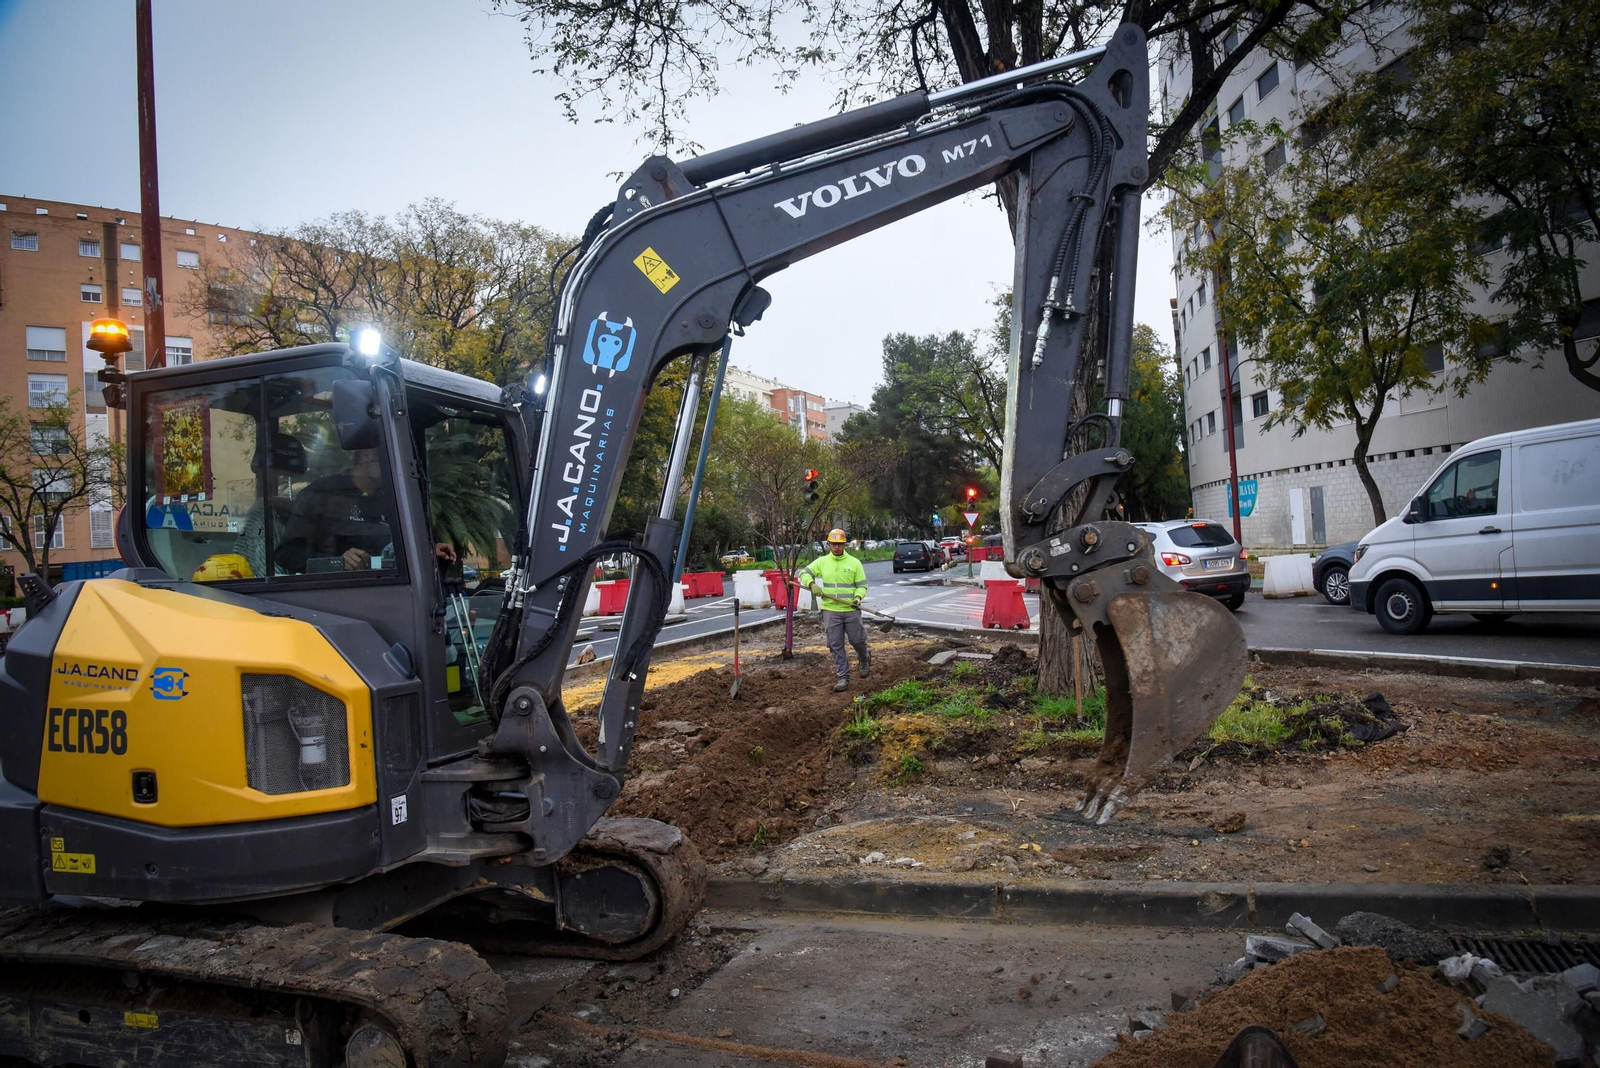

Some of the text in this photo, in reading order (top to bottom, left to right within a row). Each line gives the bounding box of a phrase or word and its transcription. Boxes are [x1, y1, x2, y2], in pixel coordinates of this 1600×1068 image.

[774, 134, 993, 219] VOLVO M71
[578, 408, 615, 533] MAQUINARIAS
[63, 680, 130, 692] MAQUINARIAS
[48, 708, 128, 755] ECR58
[395, 806, 402, 822] 97
